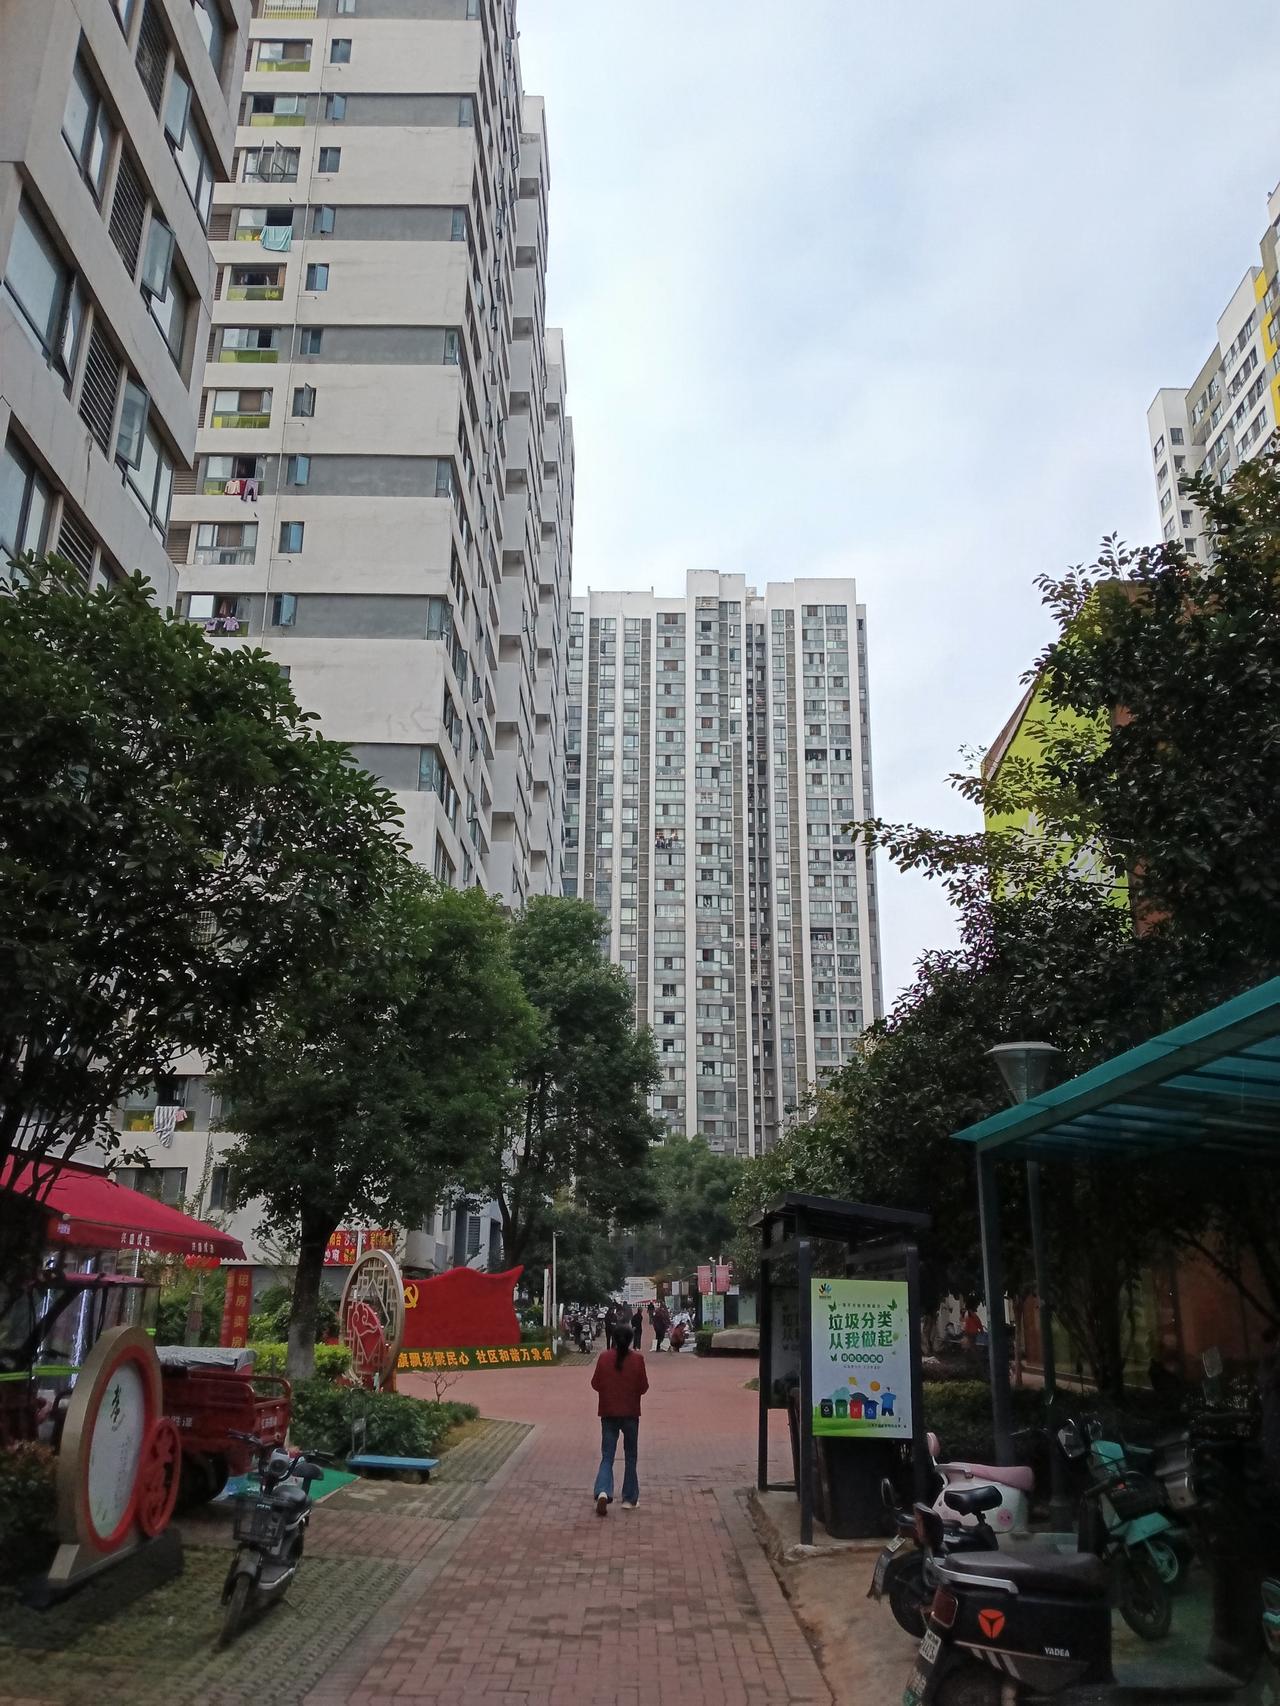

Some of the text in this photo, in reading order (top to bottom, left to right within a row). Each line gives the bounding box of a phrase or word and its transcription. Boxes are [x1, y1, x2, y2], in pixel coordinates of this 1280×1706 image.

[828, 1311, 892, 1331] 垃圾分类
[828, 1330, 893, 1350] 从我做起
[1044, 1647, 1070, 1657] YADEA
